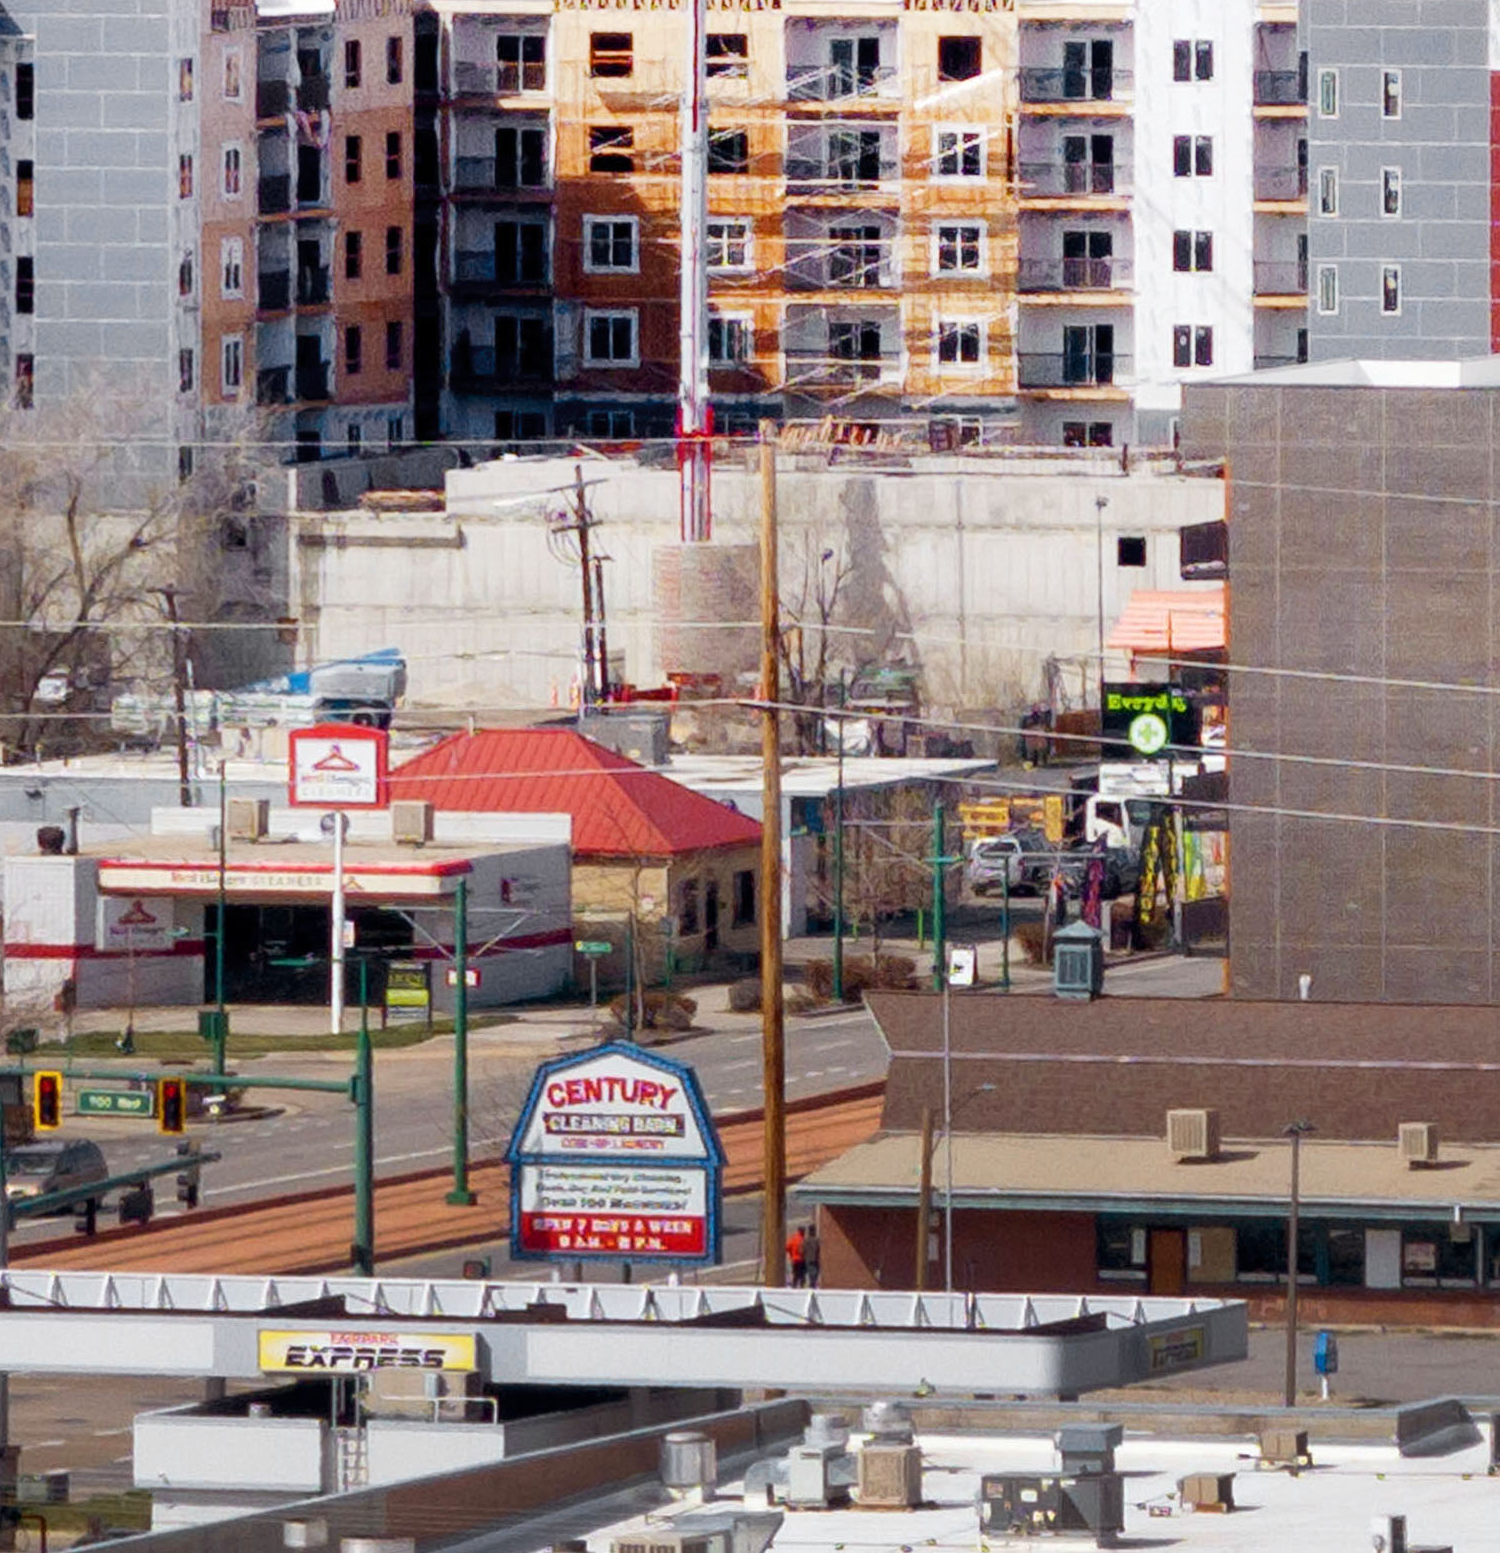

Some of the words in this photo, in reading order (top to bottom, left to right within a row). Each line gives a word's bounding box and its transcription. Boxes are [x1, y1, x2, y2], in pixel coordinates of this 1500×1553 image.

[547, 1076, 678, 1110] CENTURY
[549, 1114, 631, 1134] CLEANING
[285, 1345, 446, 1370] EXPRESS
